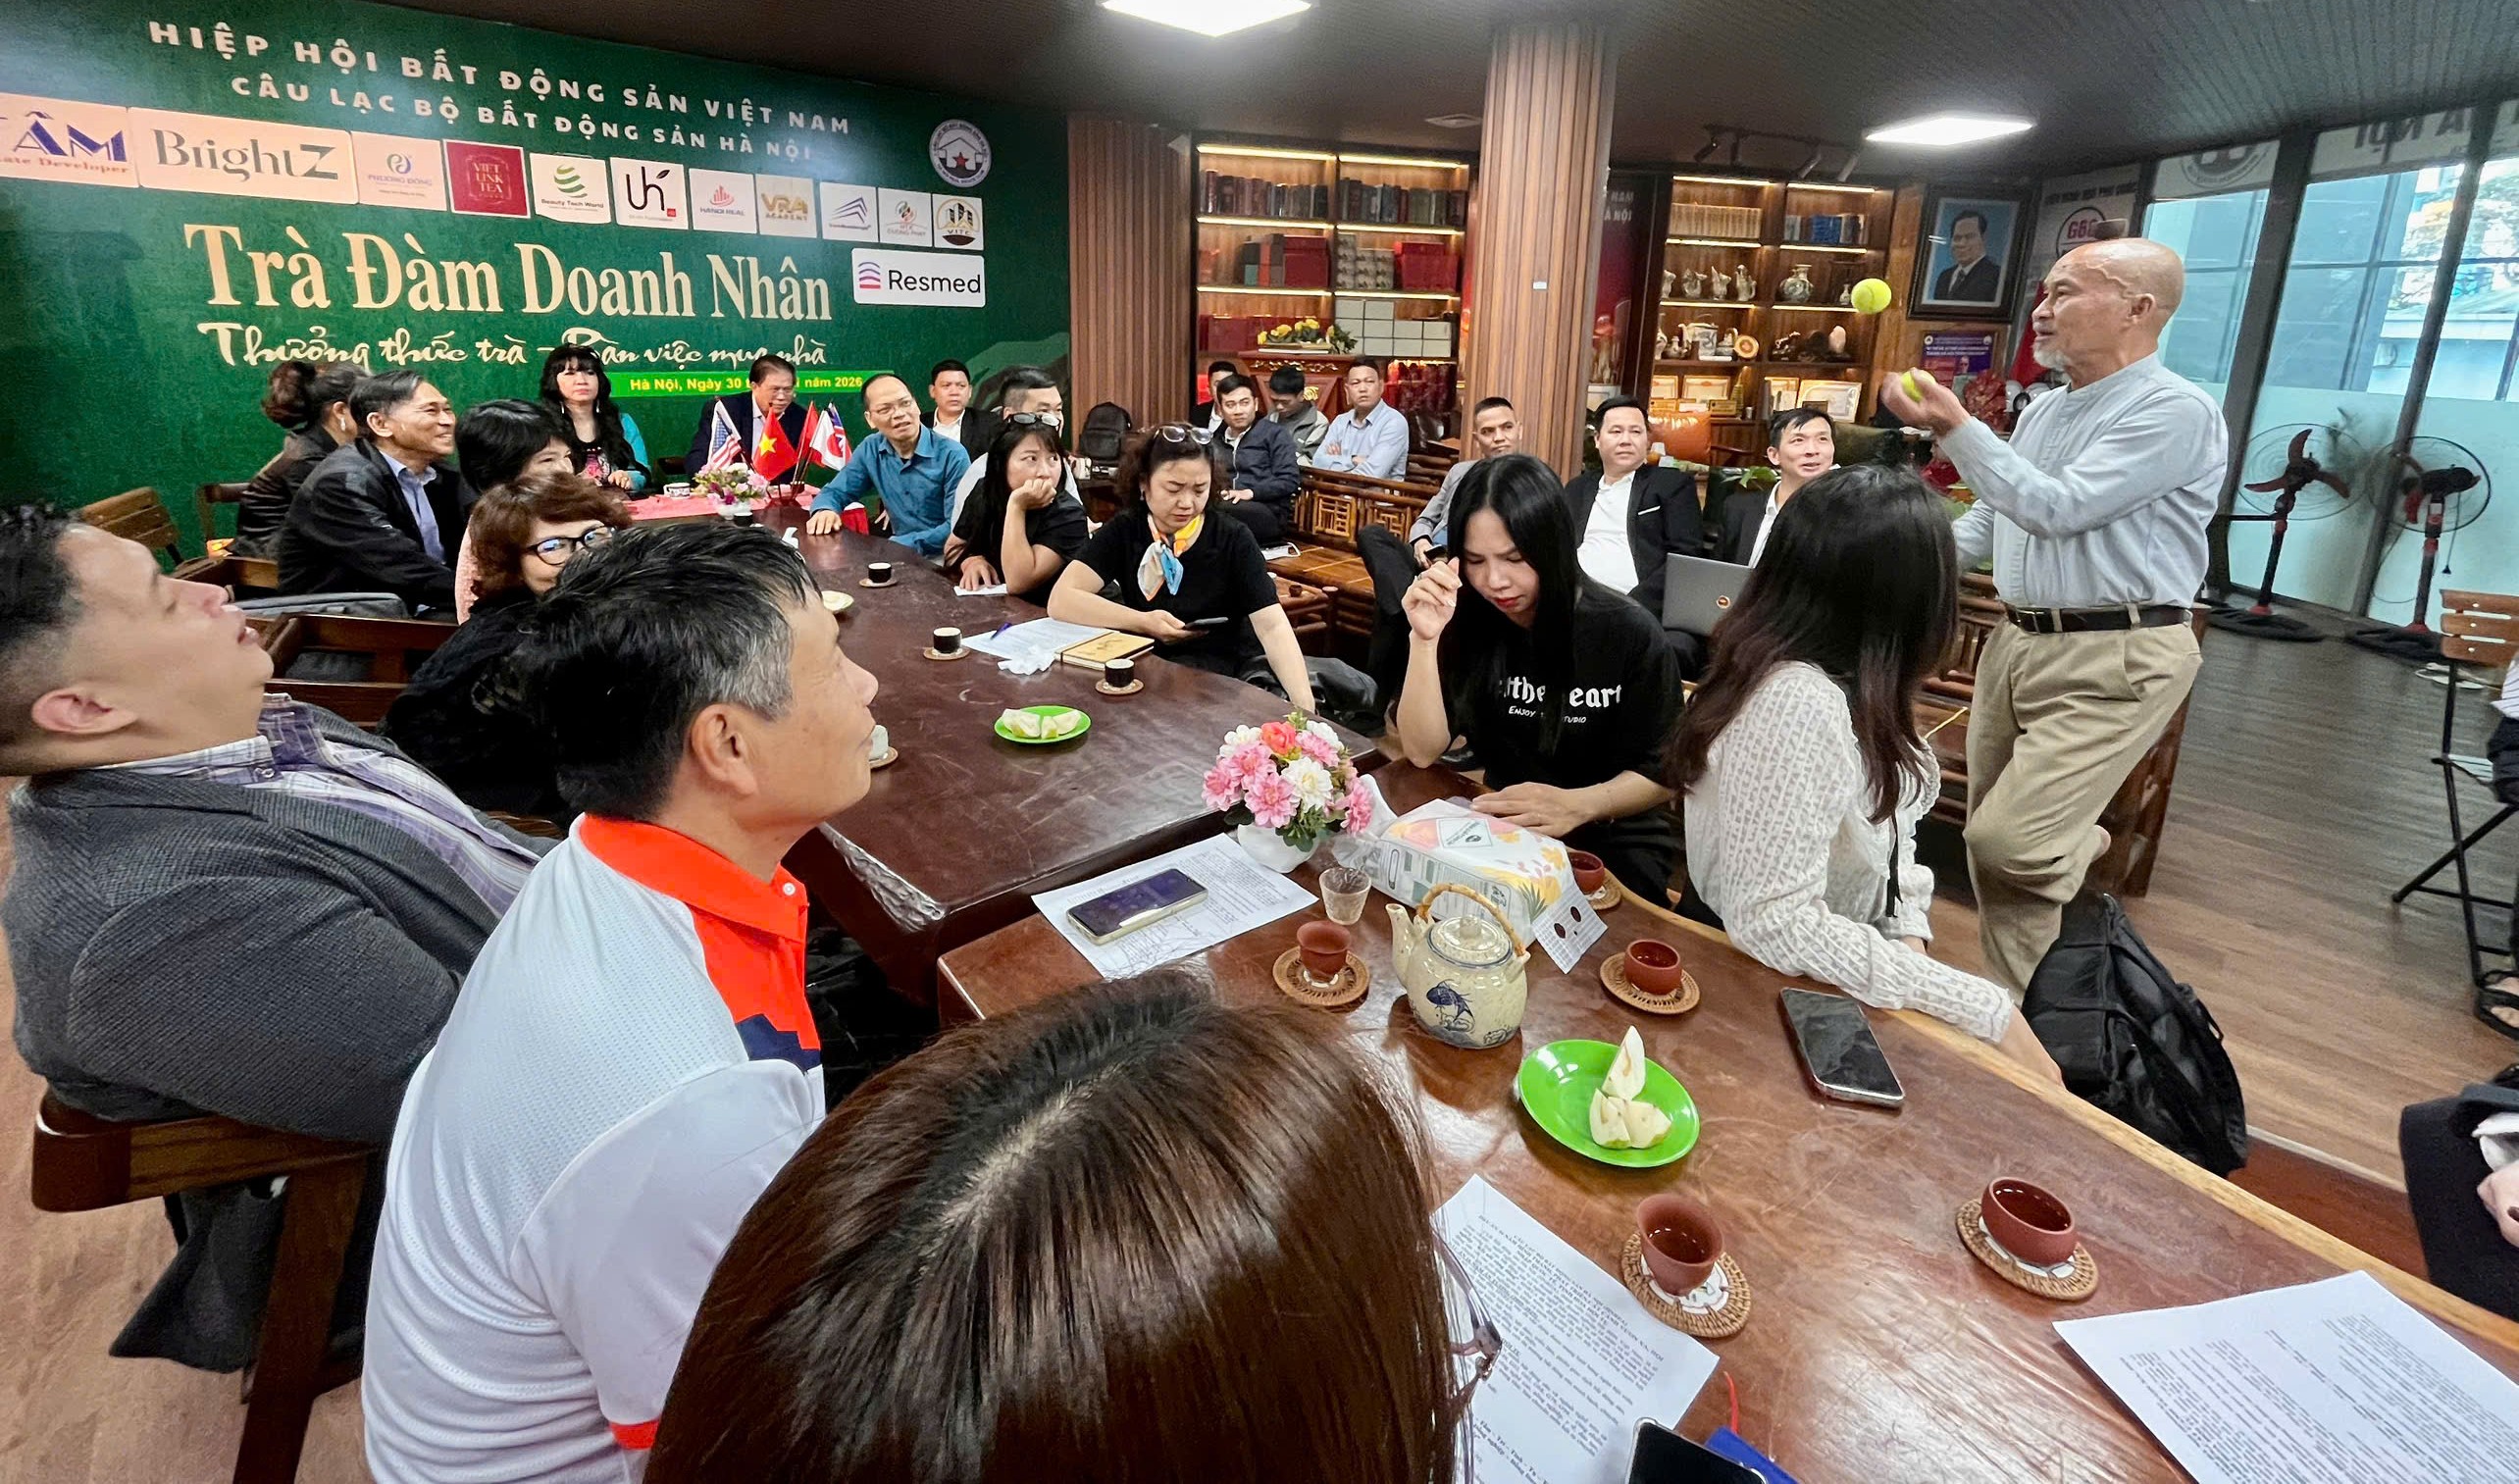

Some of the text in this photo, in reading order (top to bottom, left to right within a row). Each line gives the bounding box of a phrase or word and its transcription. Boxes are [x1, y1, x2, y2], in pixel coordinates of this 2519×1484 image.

[149, 21, 849, 134] HIỆP HỘI BẤT ĐỘNG SẢN VIỆT NAM
[231, 72, 810, 162] CÂU LẠC BỘ BẤT ĐỘNG SẢN HÀ NỘI
[0, 111, 128, 163] ÂM
[39, 156, 129, 175] Developer
[151, 128, 339, 182] BrightZ
[476, 173, 503, 183] LINK
[479, 182, 503, 193] TEA
[541, 198, 565, 207] Beauty
[761, 193, 808, 215] VRA
[1614, 208, 1632, 225] NỘI
[183, 223, 833, 322] Trà Đàm Doanh Nhân
[888, 270, 981, 293] Resmed
[197, 322, 374, 377] Thưởng
[378, 327, 469, 366] thức
[475, 333, 529, 366] trà
[561, 327, 640, 366] Bàn
[643, 339, 704, 370] việc
[776, 333, 827, 366] nhà
[630, 379, 655, 390] Hà
[657, 378, 683, 392] Nội,
[687, 378, 723, 392] Ngày
[726, 378, 742, 388] 30
[804, 377, 832, 387] năm
[835, 377, 863, 387] 2026
[1569, 684, 1621, 707] eart
[1508, 705, 1536, 717] ENJOY
